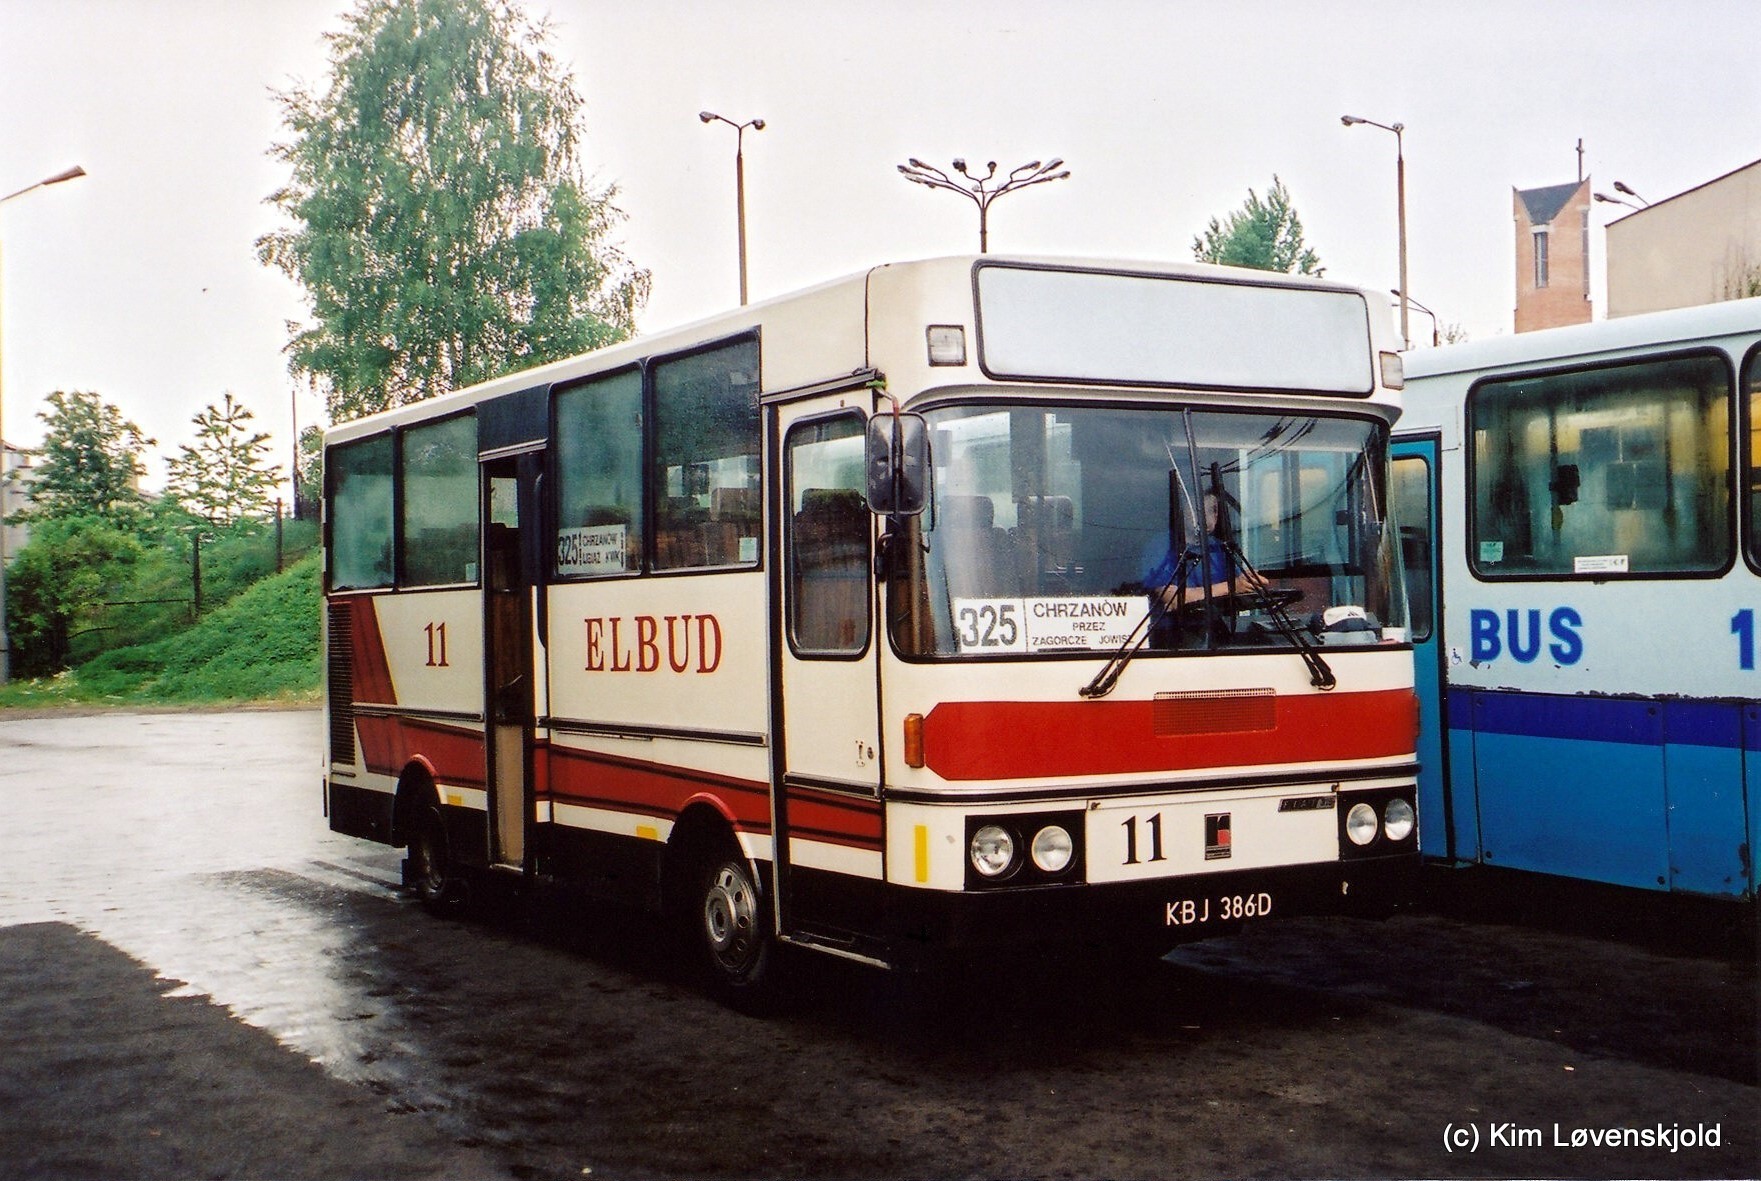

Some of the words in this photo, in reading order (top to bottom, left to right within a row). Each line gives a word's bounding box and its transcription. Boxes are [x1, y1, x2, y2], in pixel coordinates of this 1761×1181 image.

[558, 533, 578, 566] 325
[424, 620, 449, 667] 11
[584, 613, 722, 674] ELBUD
[959, 604, 1018, 647] 325
[1072, 622, 1106, 631] PRZEZ
[1470, 606, 1583, 666] BUS
[1121, 811, 1167, 866] 11
[1166, 898, 1210, 926] KBJ
[1220, 892, 1272, 920] 386D
